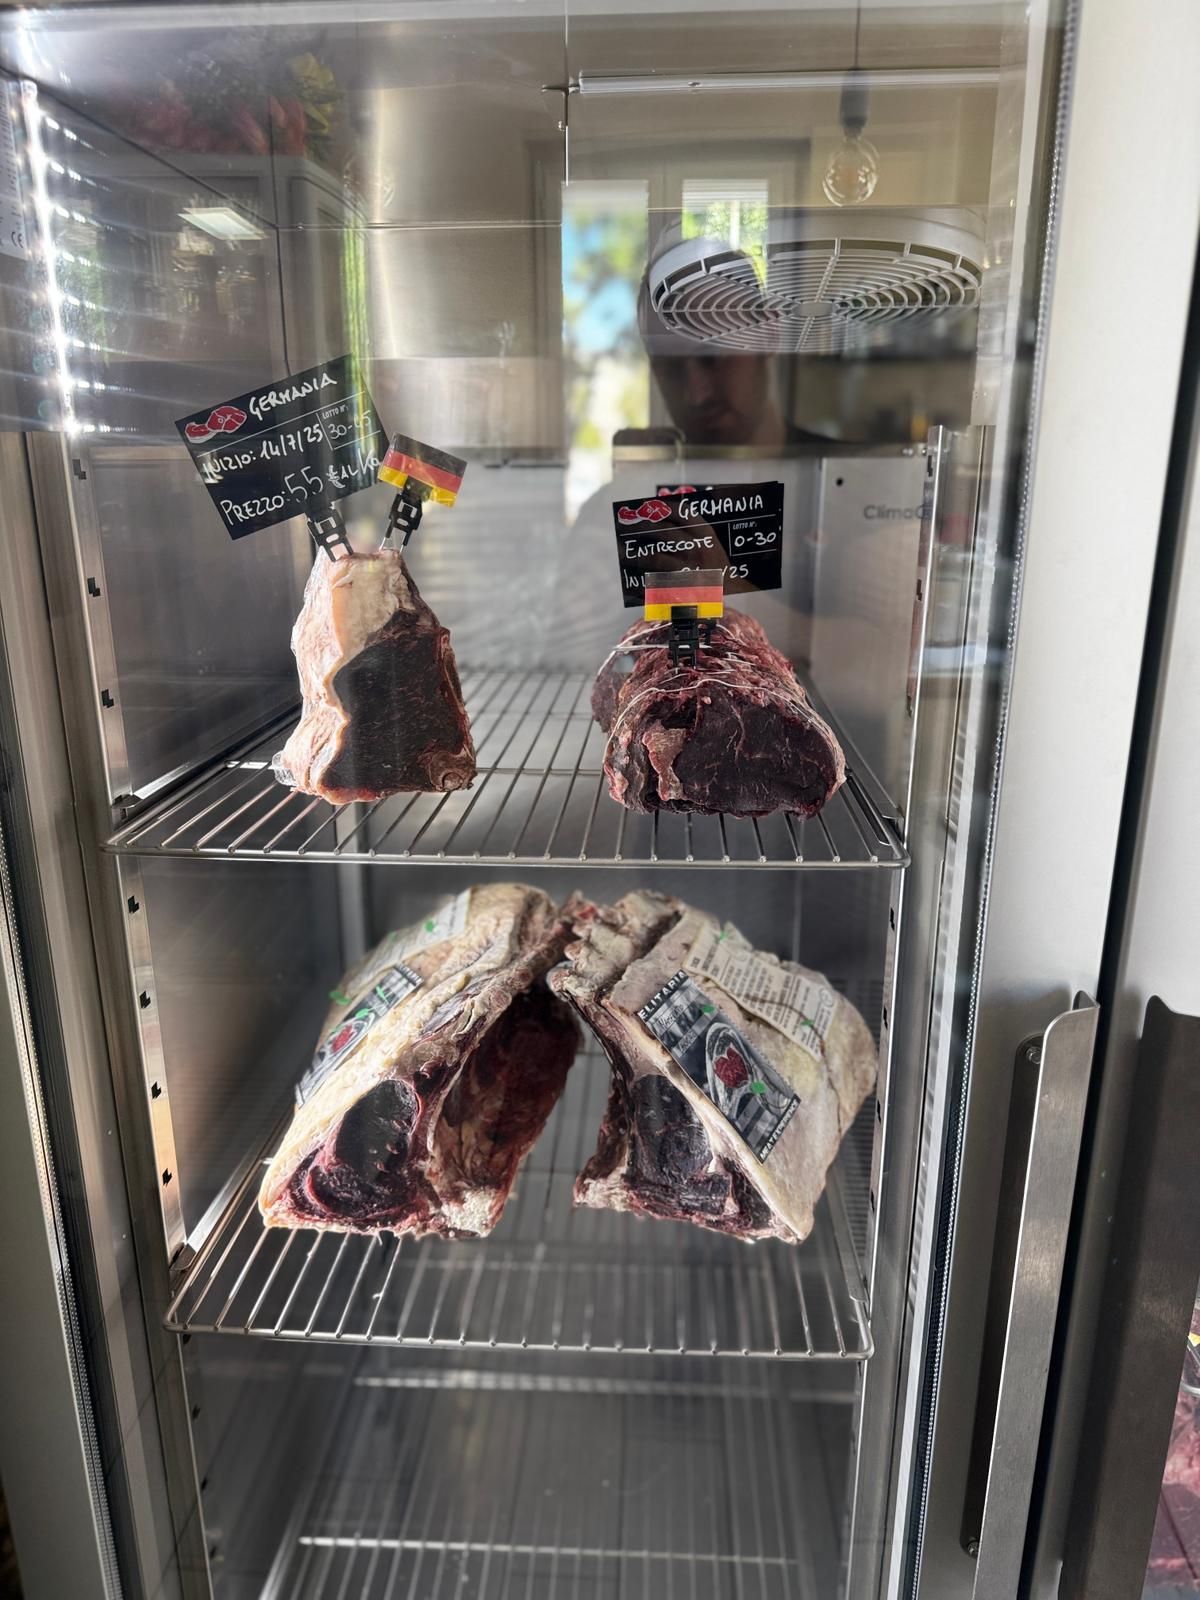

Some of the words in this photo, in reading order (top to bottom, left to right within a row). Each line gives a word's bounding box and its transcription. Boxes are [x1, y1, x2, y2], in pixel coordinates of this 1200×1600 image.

[249, 372, 338, 421] GERMANIA
[260, 423, 323, 460] 14/7/25
[284, 465, 324, 503] 55
[678, 494, 764, 520] GERMANIA
[624, 536, 715, 559] ENTRECOTE
[734, 531, 777, 547] 0-30
[636, 969, 686, 1020] ELITARIA
